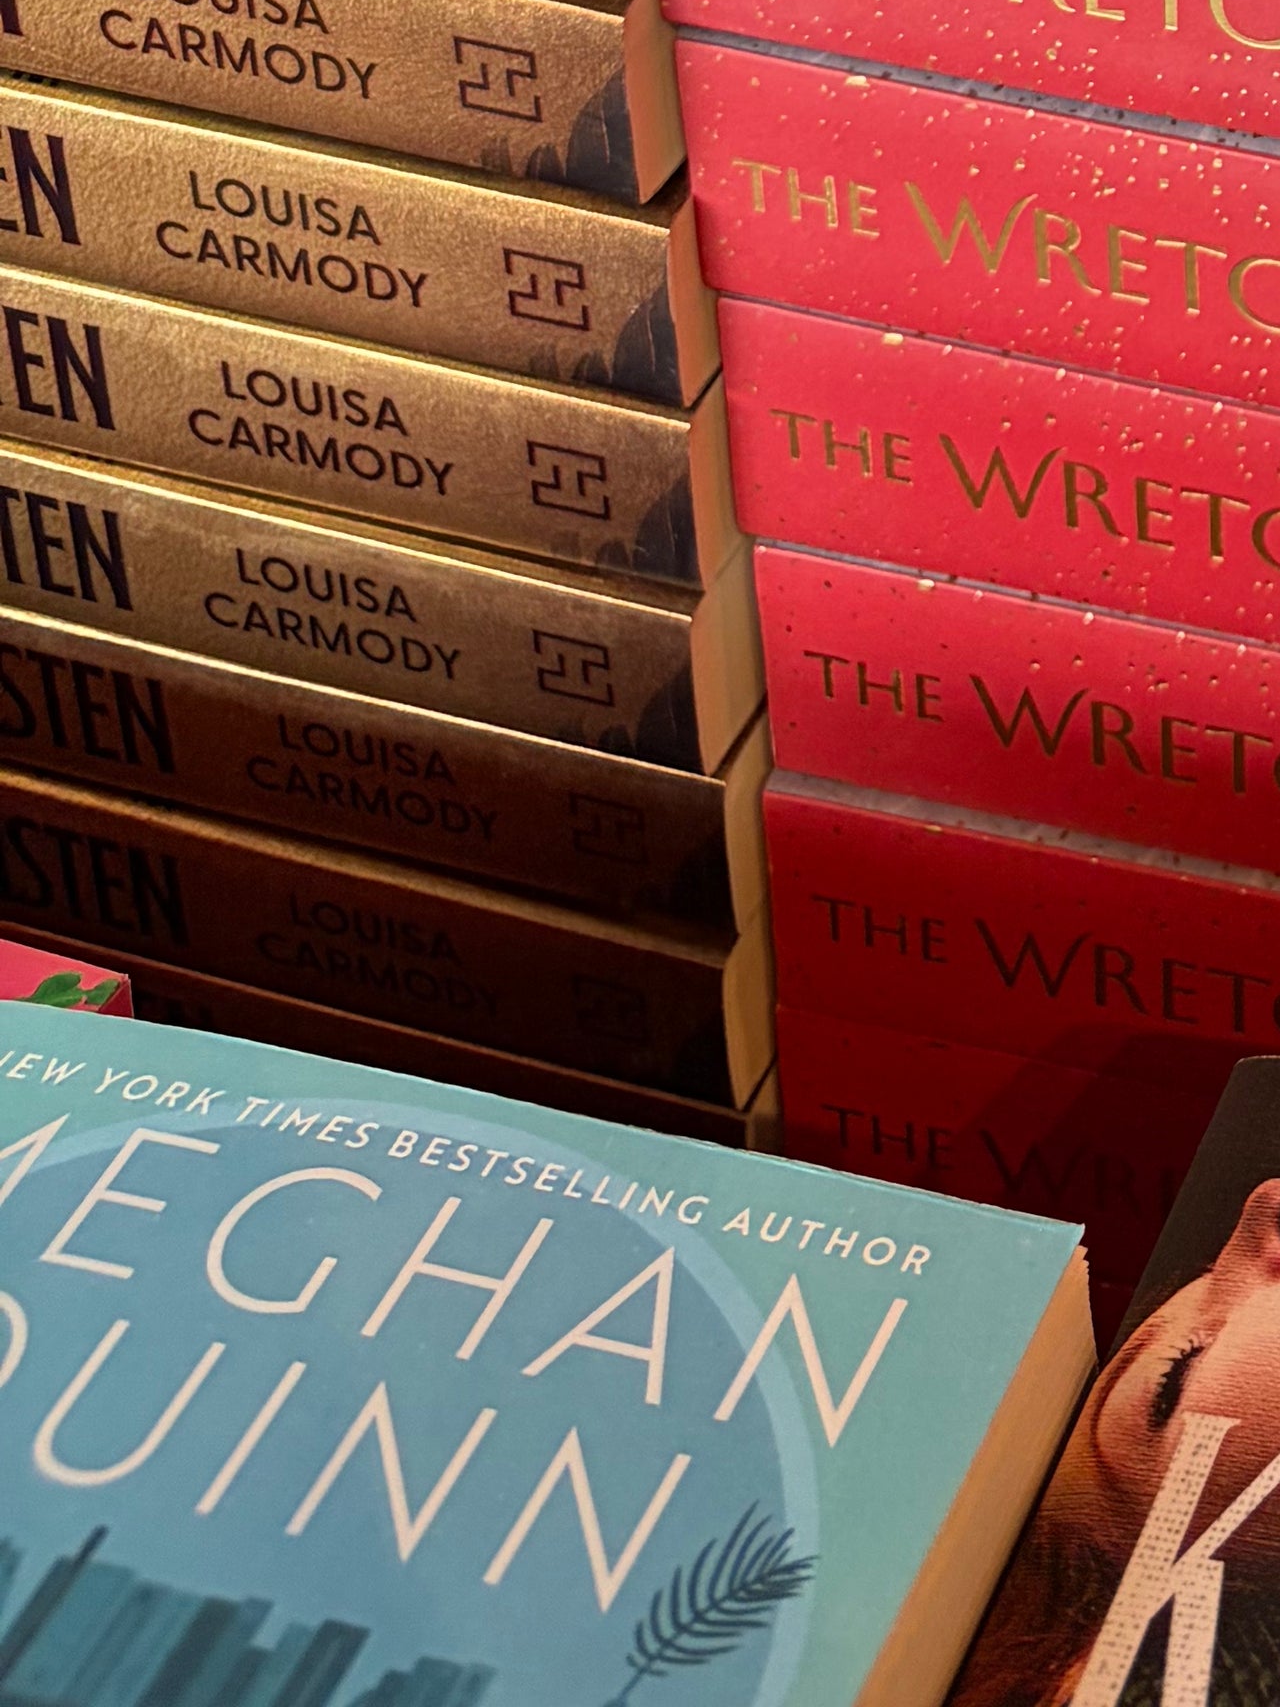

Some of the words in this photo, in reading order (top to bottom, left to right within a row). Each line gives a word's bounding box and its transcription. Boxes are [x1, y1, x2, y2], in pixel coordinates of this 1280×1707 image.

[100, 10, 378, 99] CARMODY
[188, 170, 382, 246] LOUISA
[731, 158, 880, 238] THE
[155, 222, 428, 309] CARMODY
[221, 361, 410, 437] LOUISA
[188, 410, 454, 497] CARMODY
[769, 408, 913, 486] THE
[236, 548, 419, 623] LOUISA
[204, 597, 462, 682] CARMODY
[803, 650, 945, 723] THE
[278, 713, 457, 786] LOUISA
[245, 757, 500, 843] CARMODY
[288, 891, 462, 968] LOUISA
[811, 896, 946, 964] THE
[255, 932, 502, 1017] CARMODY
[94, 1068, 226, 1115] YORK
[235, 1096, 381, 1149] TIMES
[386, 1130, 710, 1226] BESTSELLING
[720, 1205, 934, 1278] AUTHOR
[0, 1290, 691, 1616] UINN
